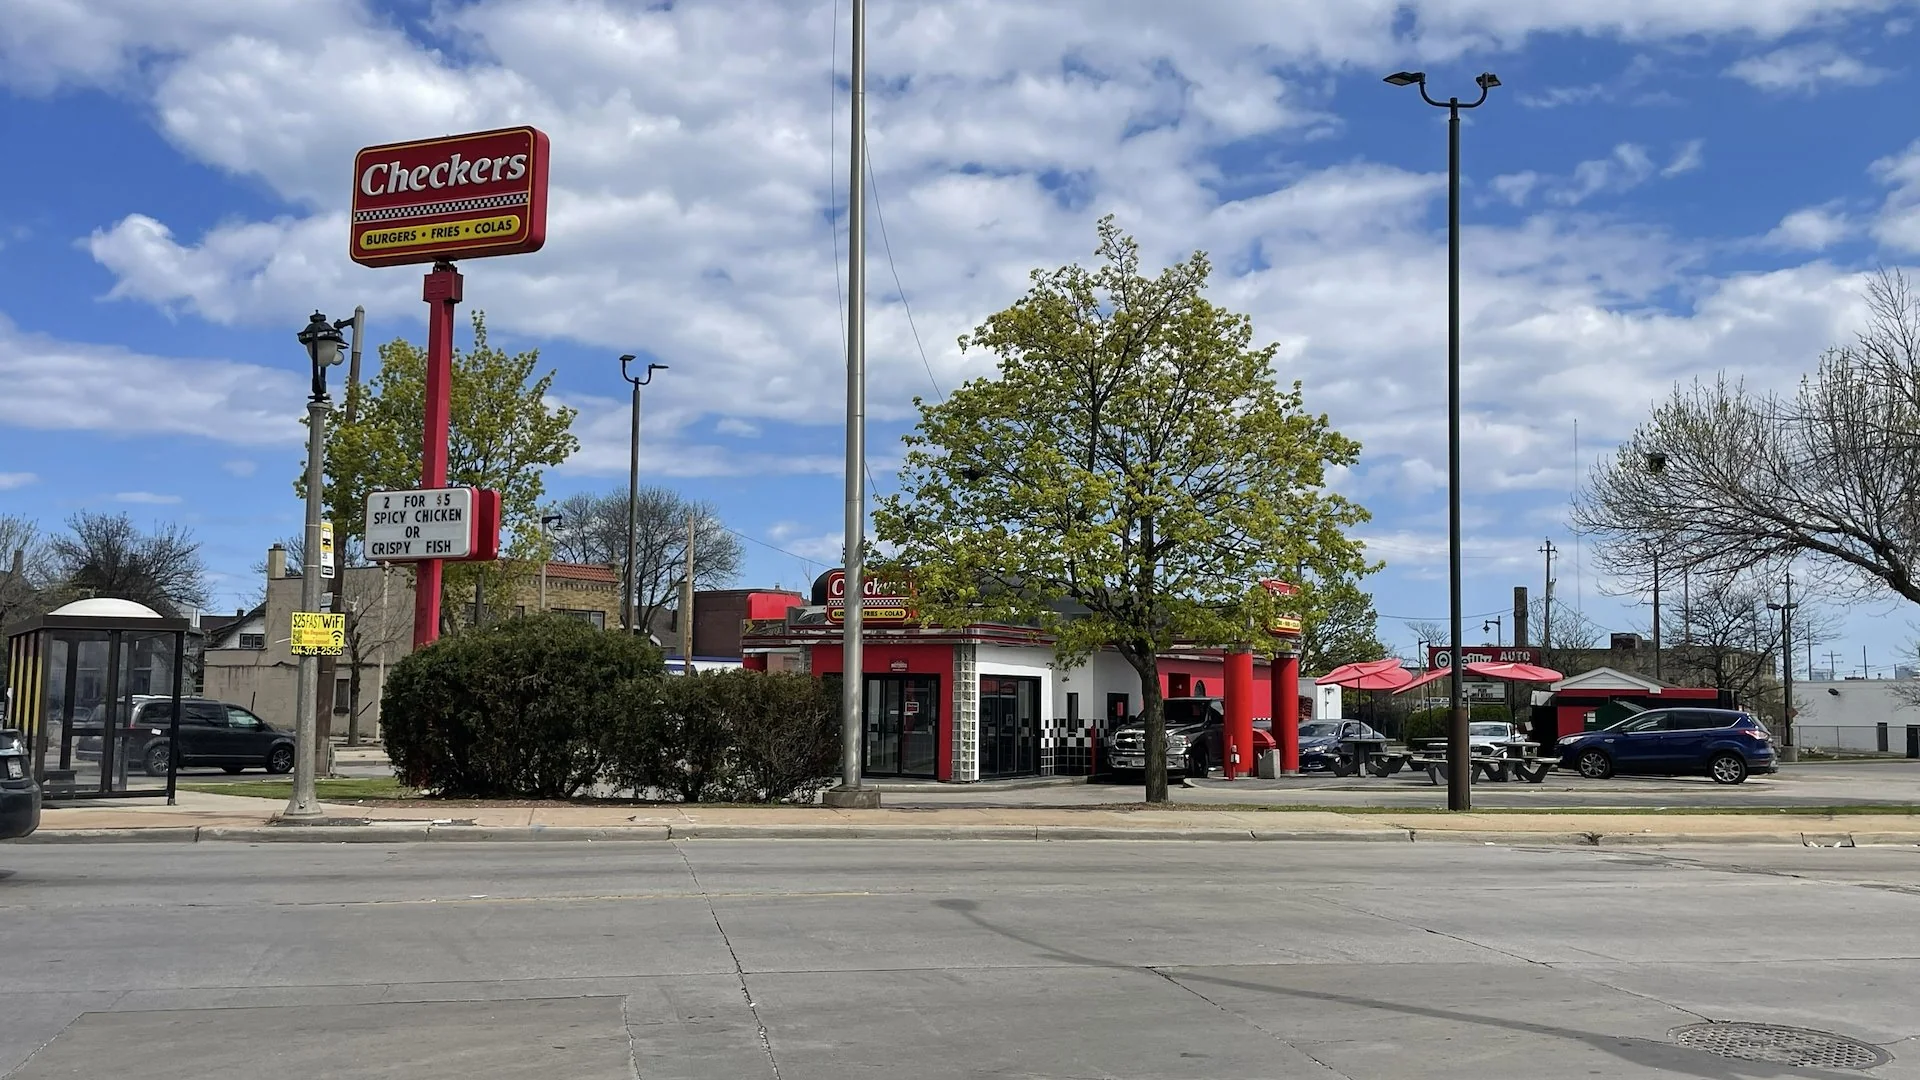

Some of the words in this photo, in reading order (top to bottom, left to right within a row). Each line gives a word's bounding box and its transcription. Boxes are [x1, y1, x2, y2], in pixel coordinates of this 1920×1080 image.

[360, 153, 528, 196] Checkers
[366, 230, 417, 245] BURGERS
[431, 225, 460, 239] FRIES
[474, 219, 512, 235] COLAS
[384, 496, 390, 509] 2
[404, 495, 425, 508] FOR
[436, 493, 450, 506] $5
[374, 511, 406, 525] SPICY
[415, 508, 461, 523] CHICKEN
[405, 526, 420, 539] OR
[372, 541, 411, 555] CRISPY
[426, 540, 451, 554] FISH
[322, 615, 344, 629] WiFi
[291, 646, 343, 656] 414-373-2525
[1499, 651, 1531, 662] AUTO
